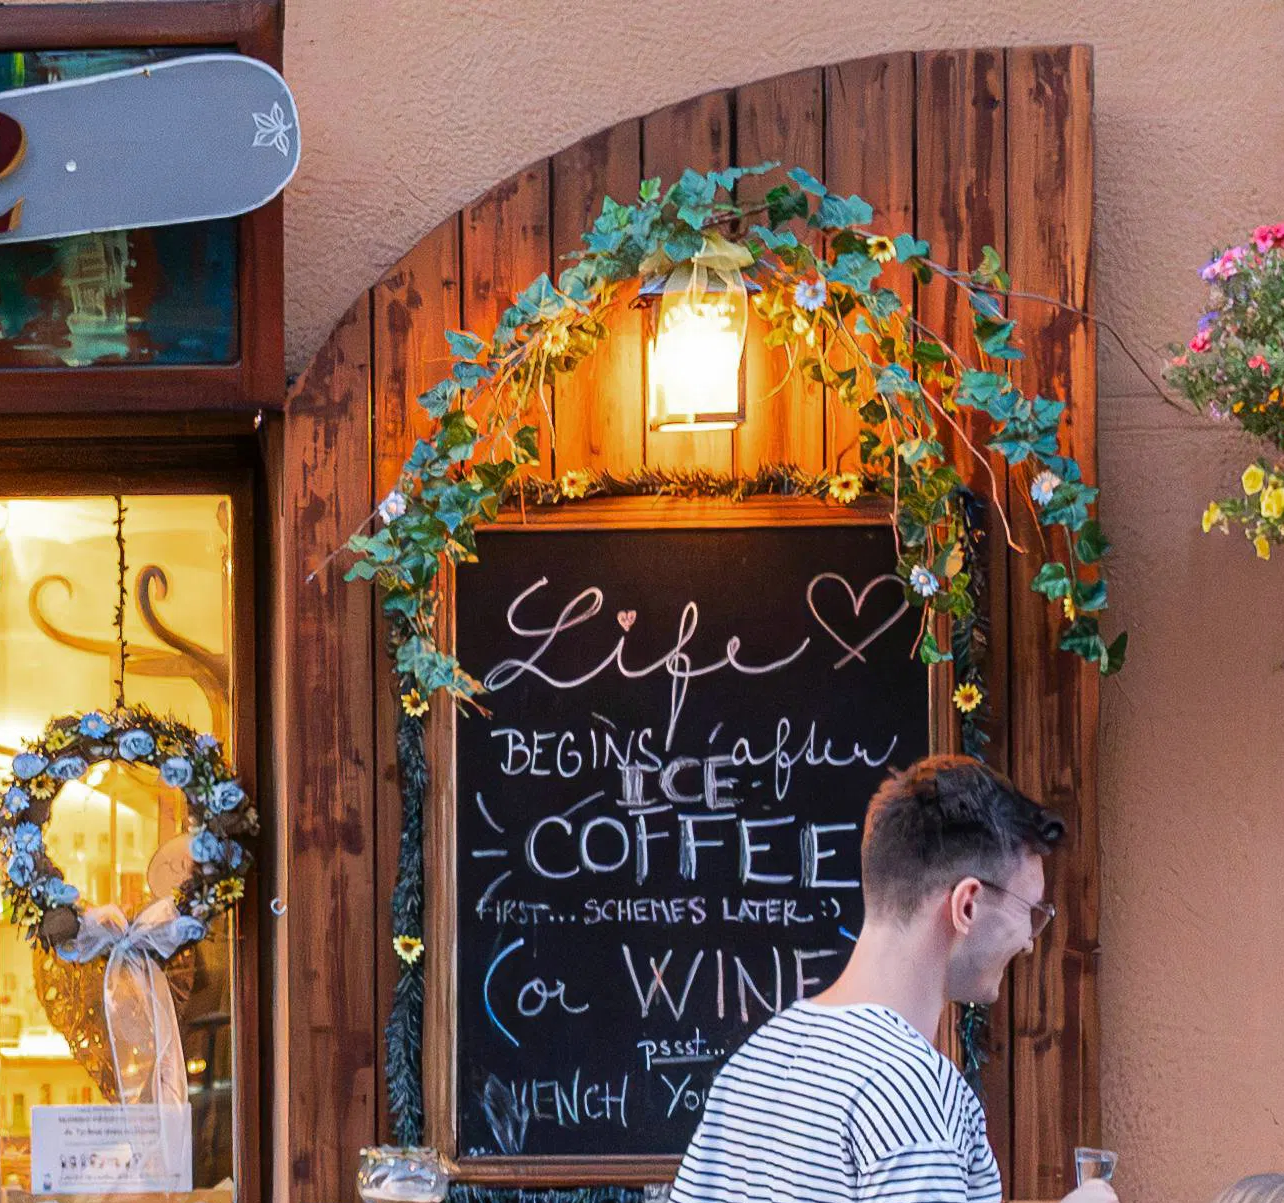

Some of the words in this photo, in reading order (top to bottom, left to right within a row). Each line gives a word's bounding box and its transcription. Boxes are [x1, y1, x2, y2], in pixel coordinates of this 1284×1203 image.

[483, 575, 810, 750] Life
[490, 727, 663, 778] BEGINS
[731, 716, 898, 801] after
[525, 804, 861, 888] COFFEE
[583, 897, 709, 926] SCHEMES
